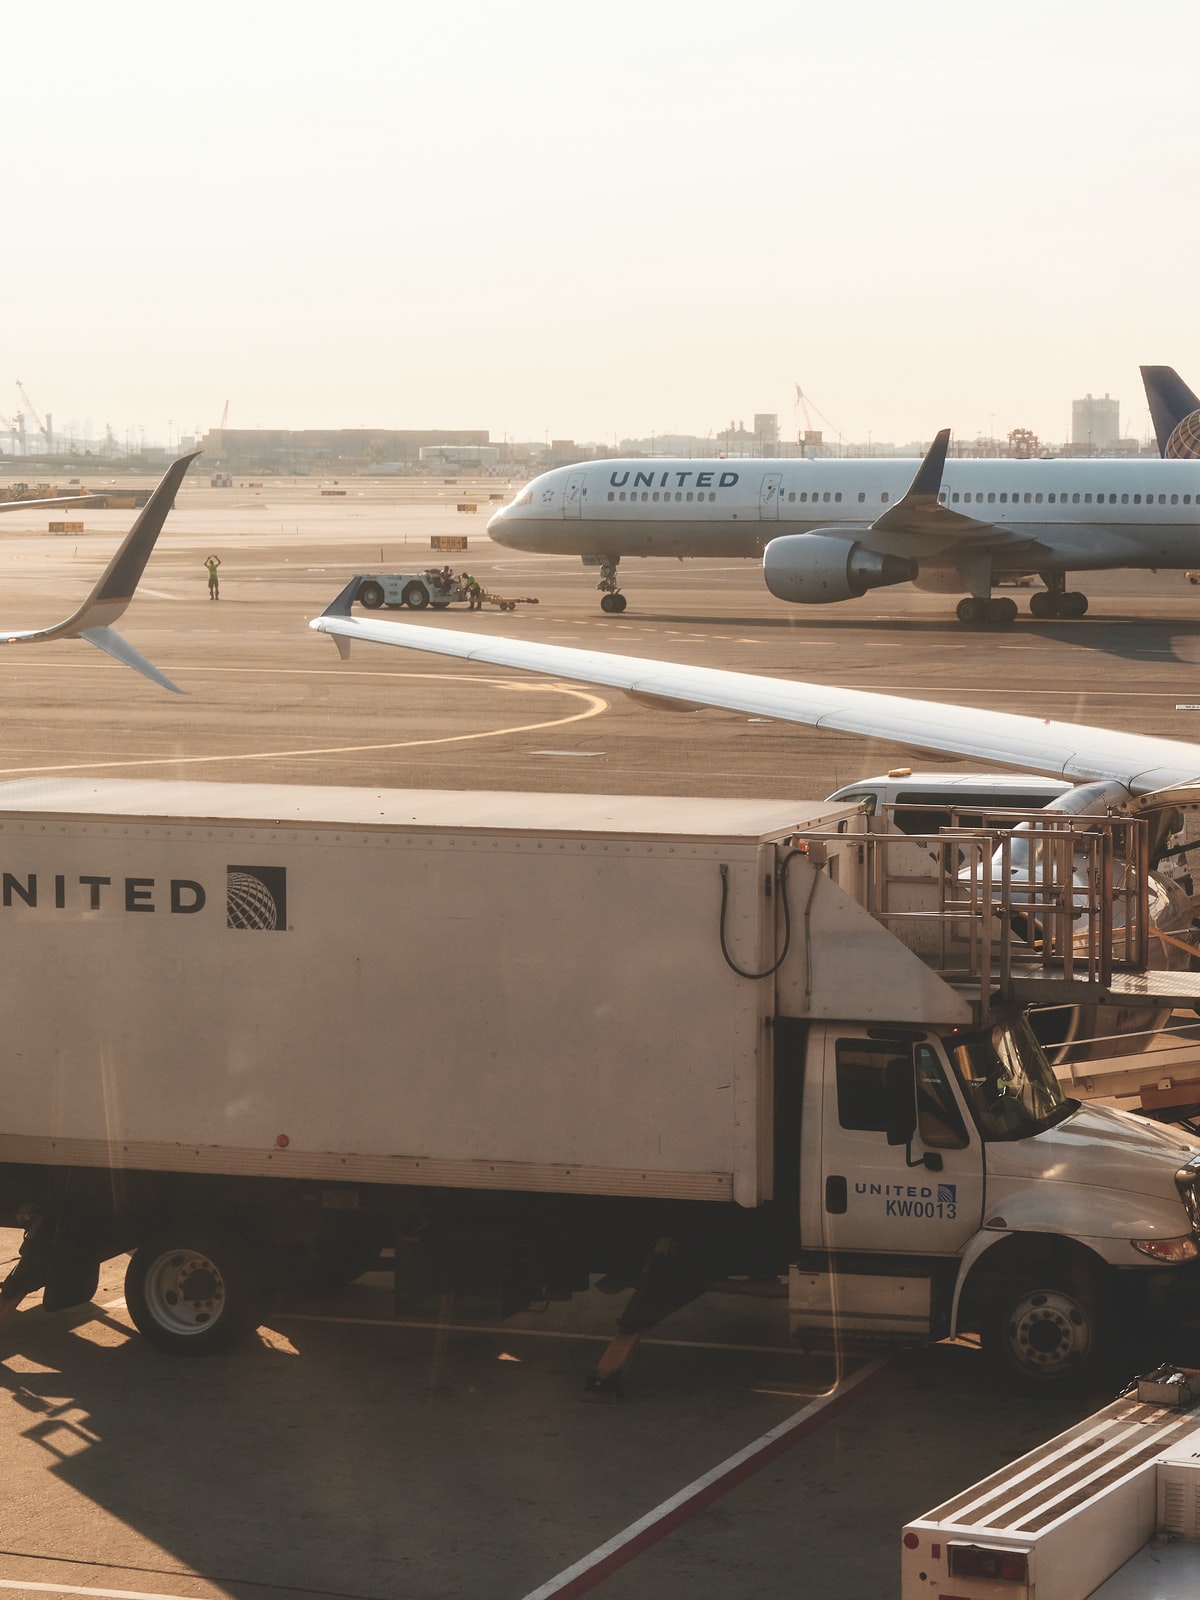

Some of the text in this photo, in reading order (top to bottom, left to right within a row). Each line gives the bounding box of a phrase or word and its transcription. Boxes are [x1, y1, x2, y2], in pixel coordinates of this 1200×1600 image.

[609, 471, 739, 488] UNITED
[2, 872, 207, 914] NITED
[854, 1183, 932, 1198] UNITED
[885, 1199, 958, 1220] KW0013
